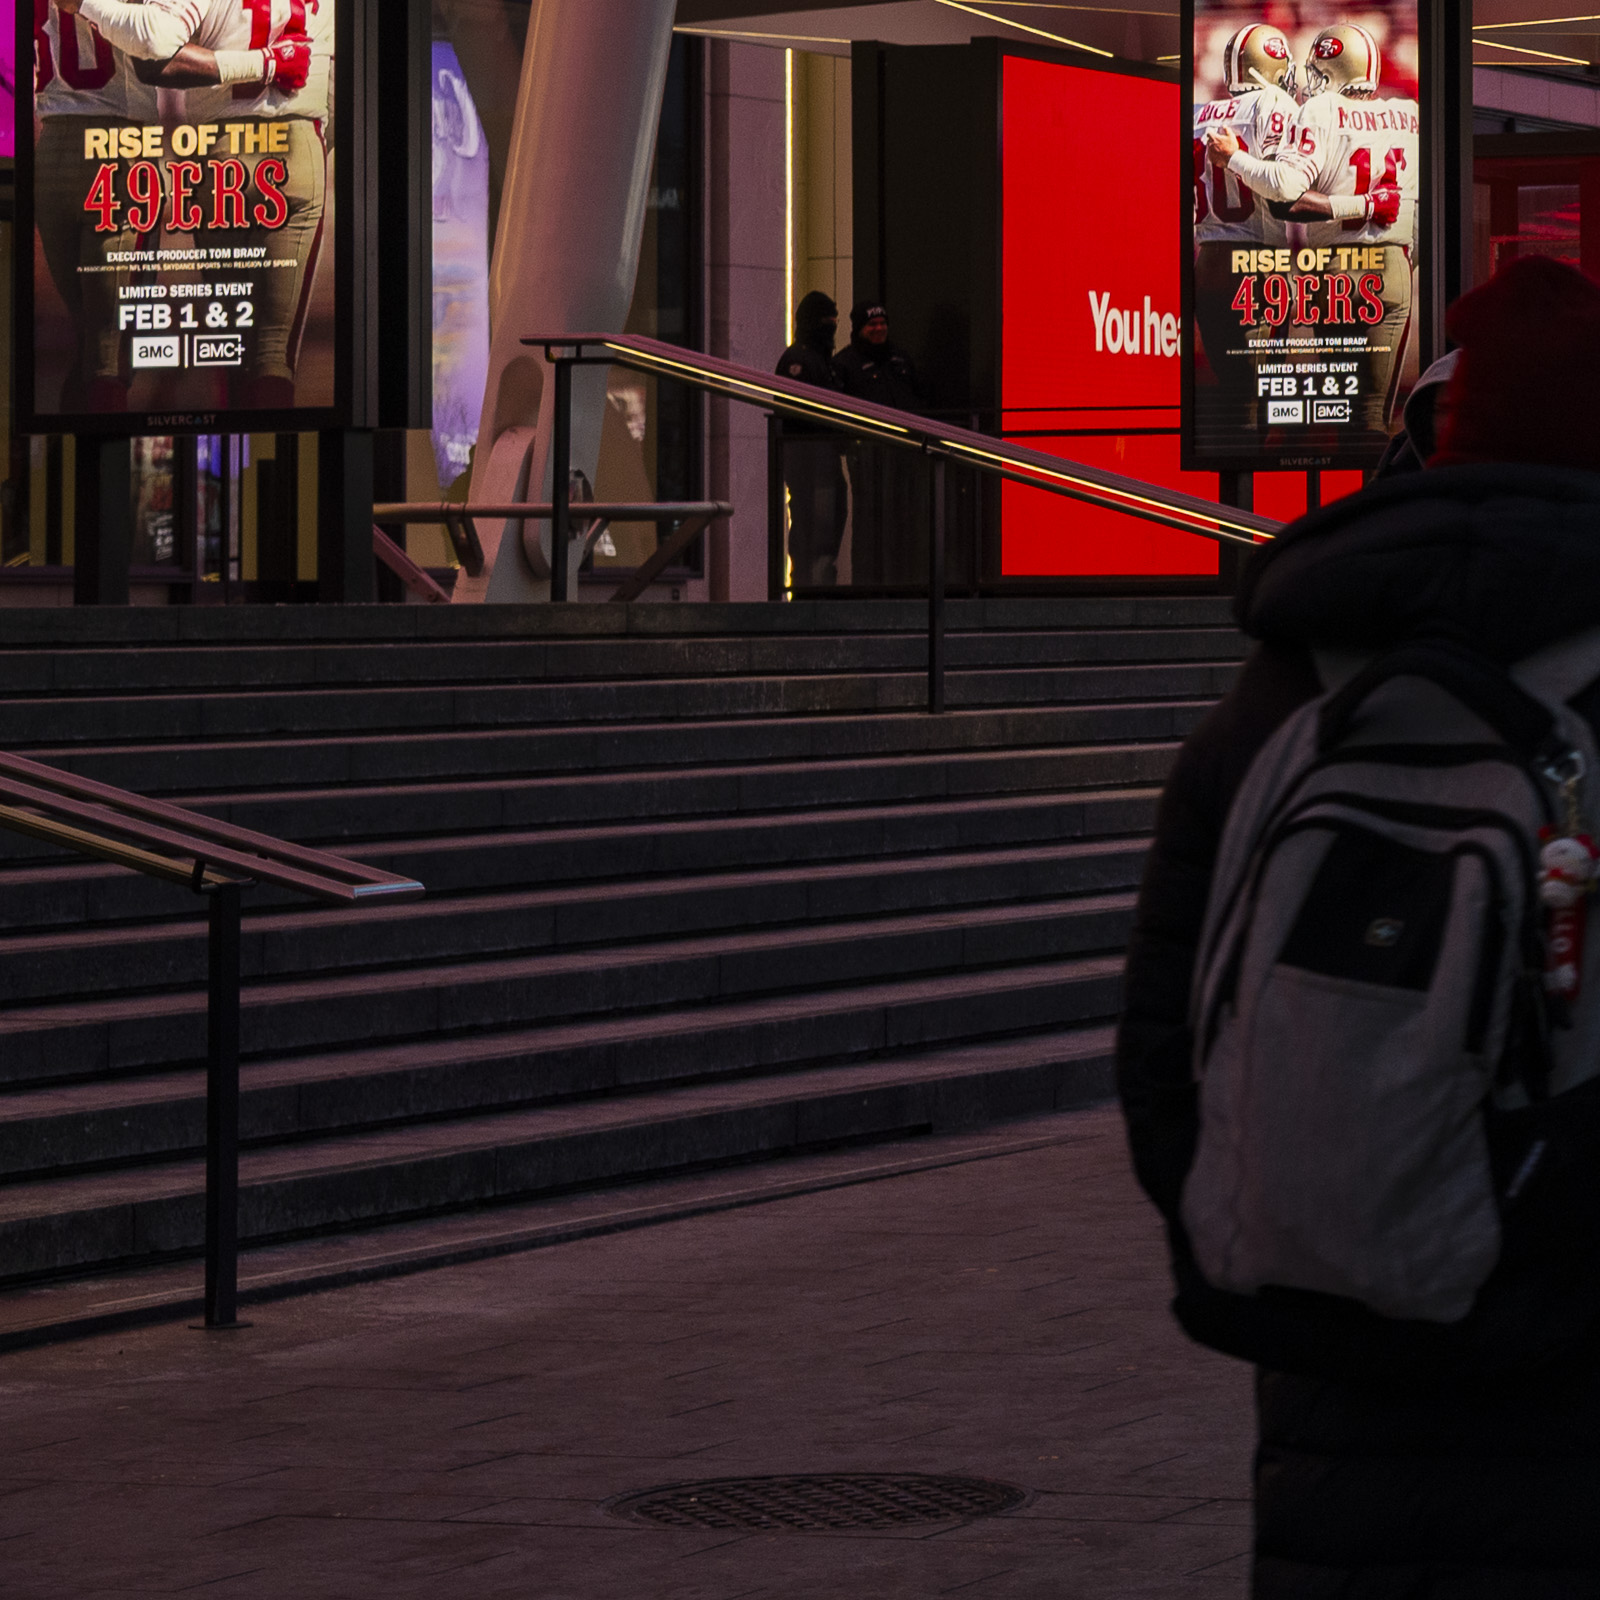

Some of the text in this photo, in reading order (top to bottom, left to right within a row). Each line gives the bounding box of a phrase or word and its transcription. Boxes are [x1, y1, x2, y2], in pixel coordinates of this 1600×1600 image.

[1198, 100, 1241, 125] RICE
[1338, 106, 1419, 135] MONTANA
[84, 122, 290, 160] RISE OF THE
[83, 157, 289, 233] 49ERS
[106, 247, 267, 263] EXECUTIVE PRODUCER TOM BRADY
[1231, 247, 1385, 274] RISE OF THE
[119, 282, 254, 299] LIMITED SERIES EVENT
[1231, 273, 1385, 327] 49ERS
[118, 301, 254, 330] FEB 1 & 2
[1088, 290, 1140, 355] You
[1248, 336, 1368, 348] EXECUTIVE PRODUCER TOM BRADY
[1257, 362, 1359, 374] LIMITED SERIES EVENT
[1257, 375, 1360, 398] FEB 1 & 2
